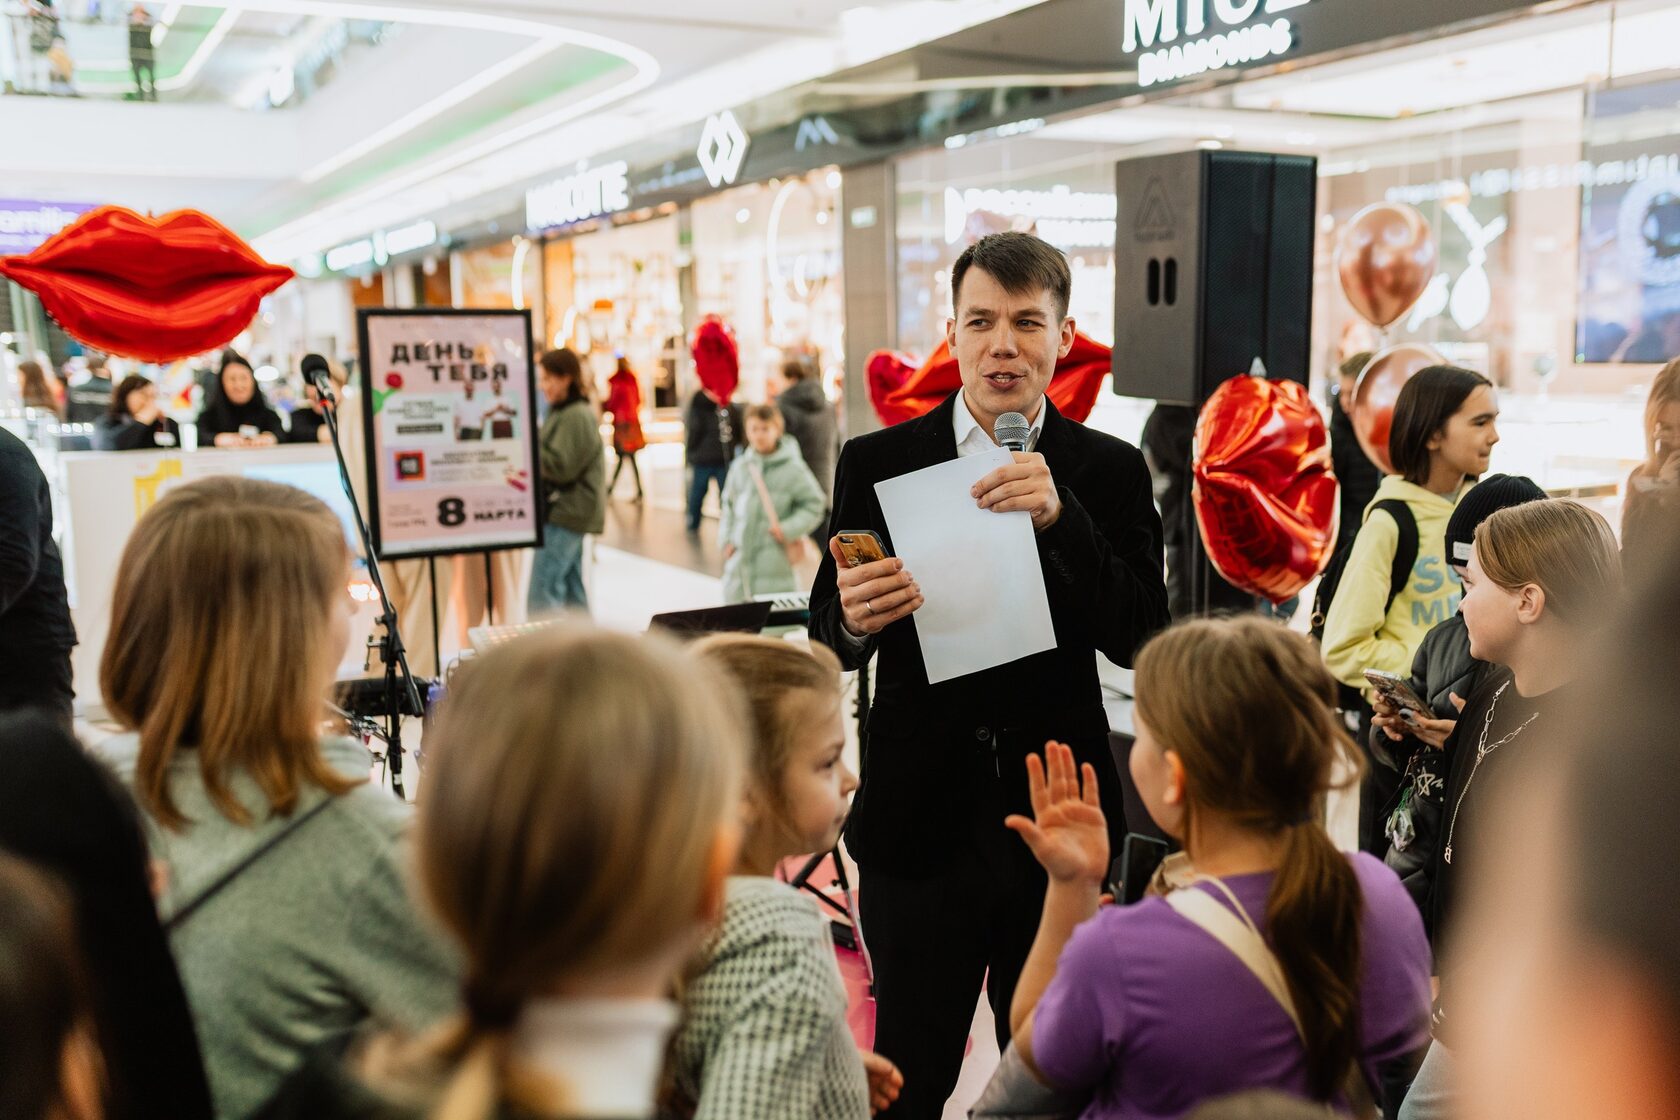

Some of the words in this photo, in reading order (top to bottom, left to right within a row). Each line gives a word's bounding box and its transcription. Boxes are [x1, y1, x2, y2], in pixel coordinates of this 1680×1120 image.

[1138, 18, 1292, 87] DIAMONDS
[391, 343, 474, 364] ДЕНЬ
[427, 364, 508, 382] ТЕБЯ
[437, 497, 467, 527] 8
[473, 508, 527, 523] МАРТА
